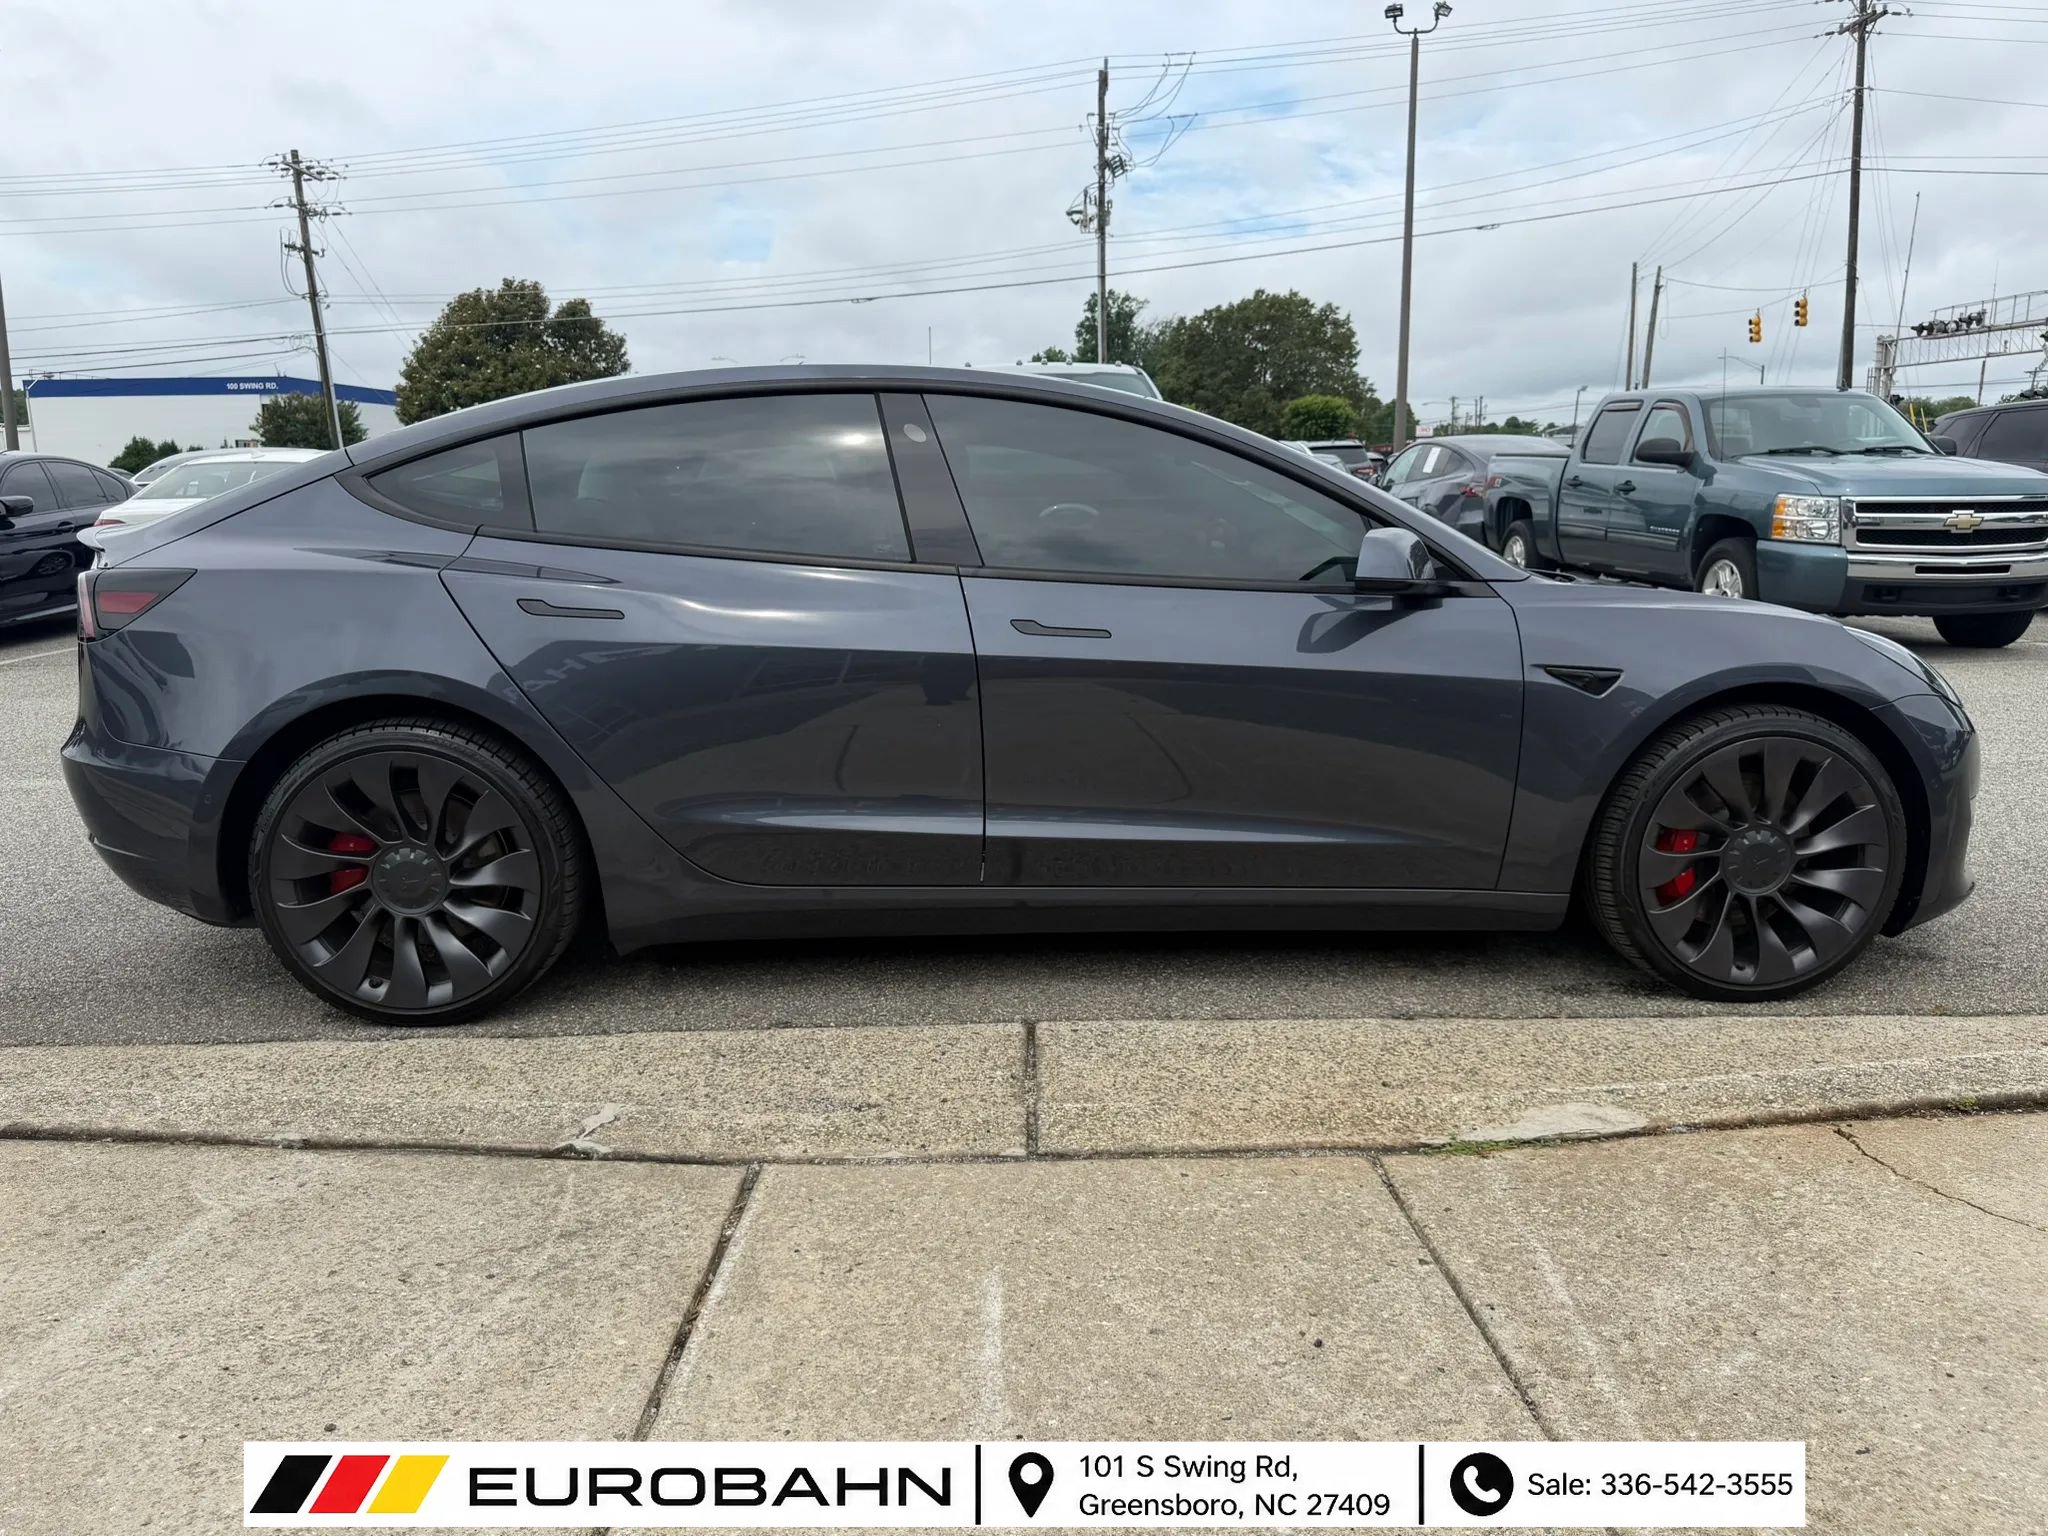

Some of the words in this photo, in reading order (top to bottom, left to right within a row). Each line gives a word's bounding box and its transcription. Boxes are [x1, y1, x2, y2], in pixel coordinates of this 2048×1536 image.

[226, 382, 239, 390] 100
[239, 382, 264, 390] SWING
[265, 382, 279, 390] RD.
